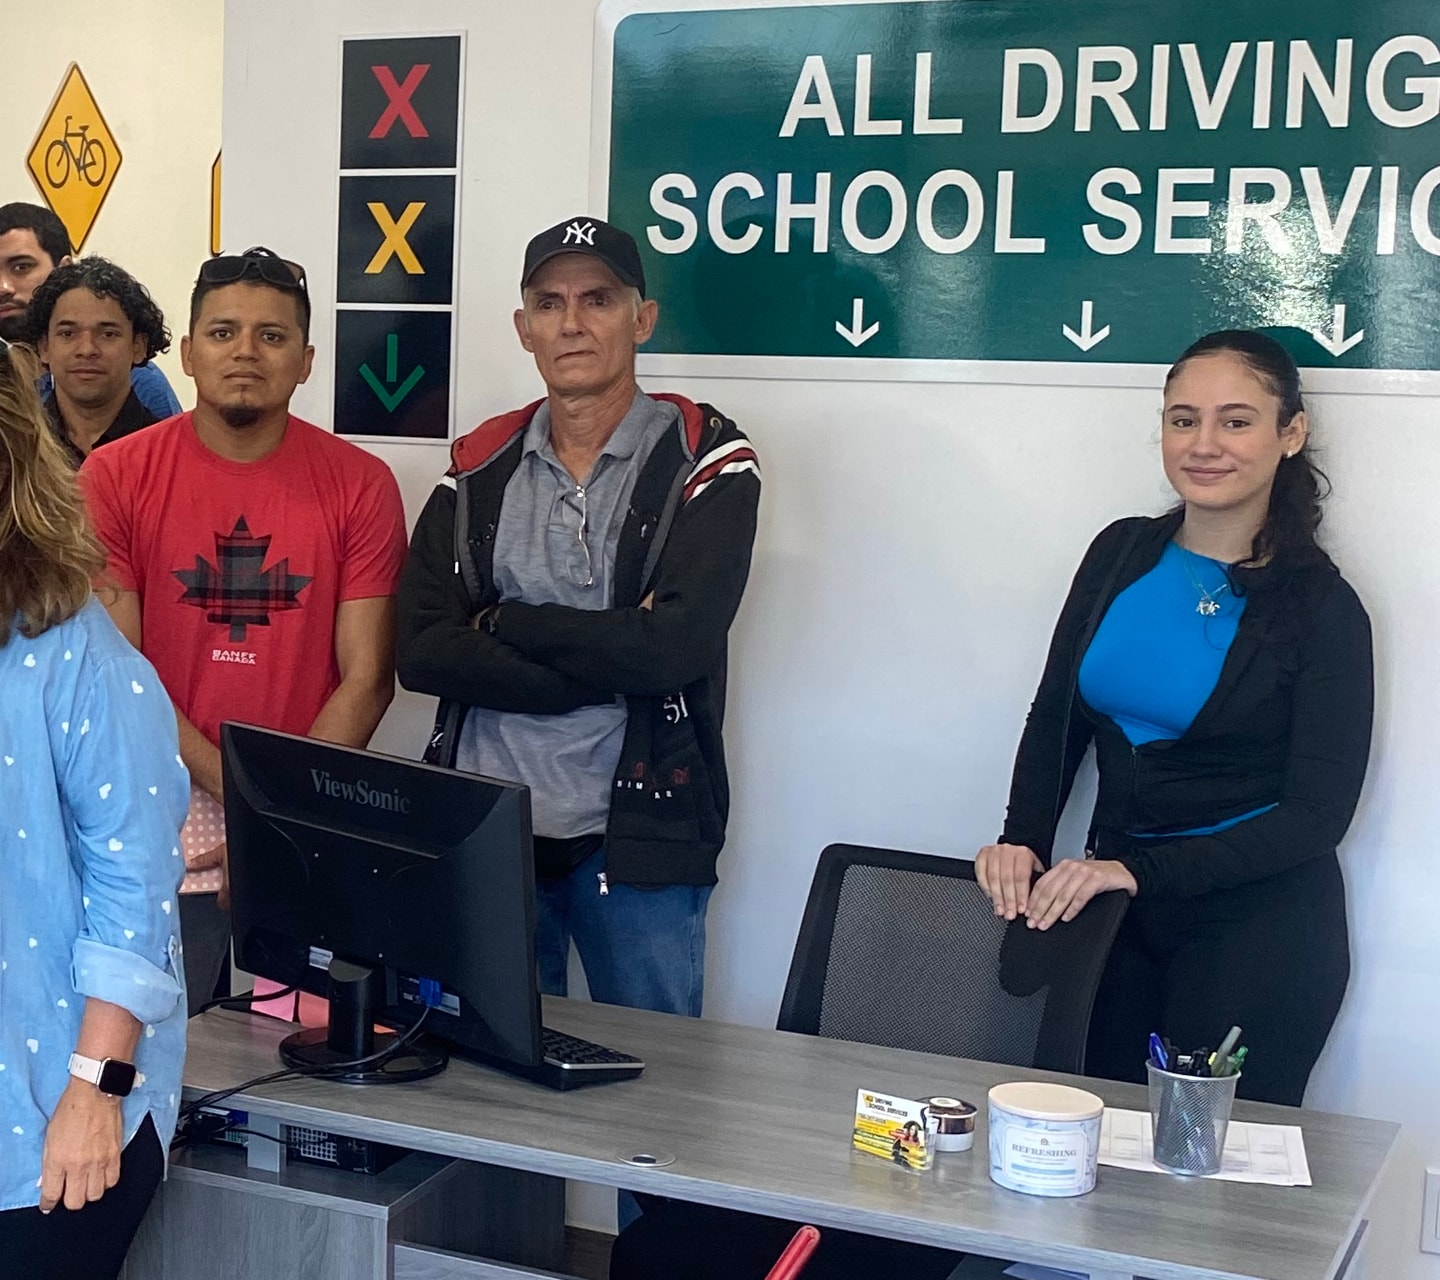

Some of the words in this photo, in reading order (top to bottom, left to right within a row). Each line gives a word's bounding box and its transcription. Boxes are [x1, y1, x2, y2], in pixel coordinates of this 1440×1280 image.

[778, 51, 963, 138] ALL
[1000, 34, 1440, 133] DRIVING
[645, 168, 1046, 255] SCHOOL
[310, 768, 411, 814] ViewSonic
[1011, 1143, 1077, 1158] REFRESHING
